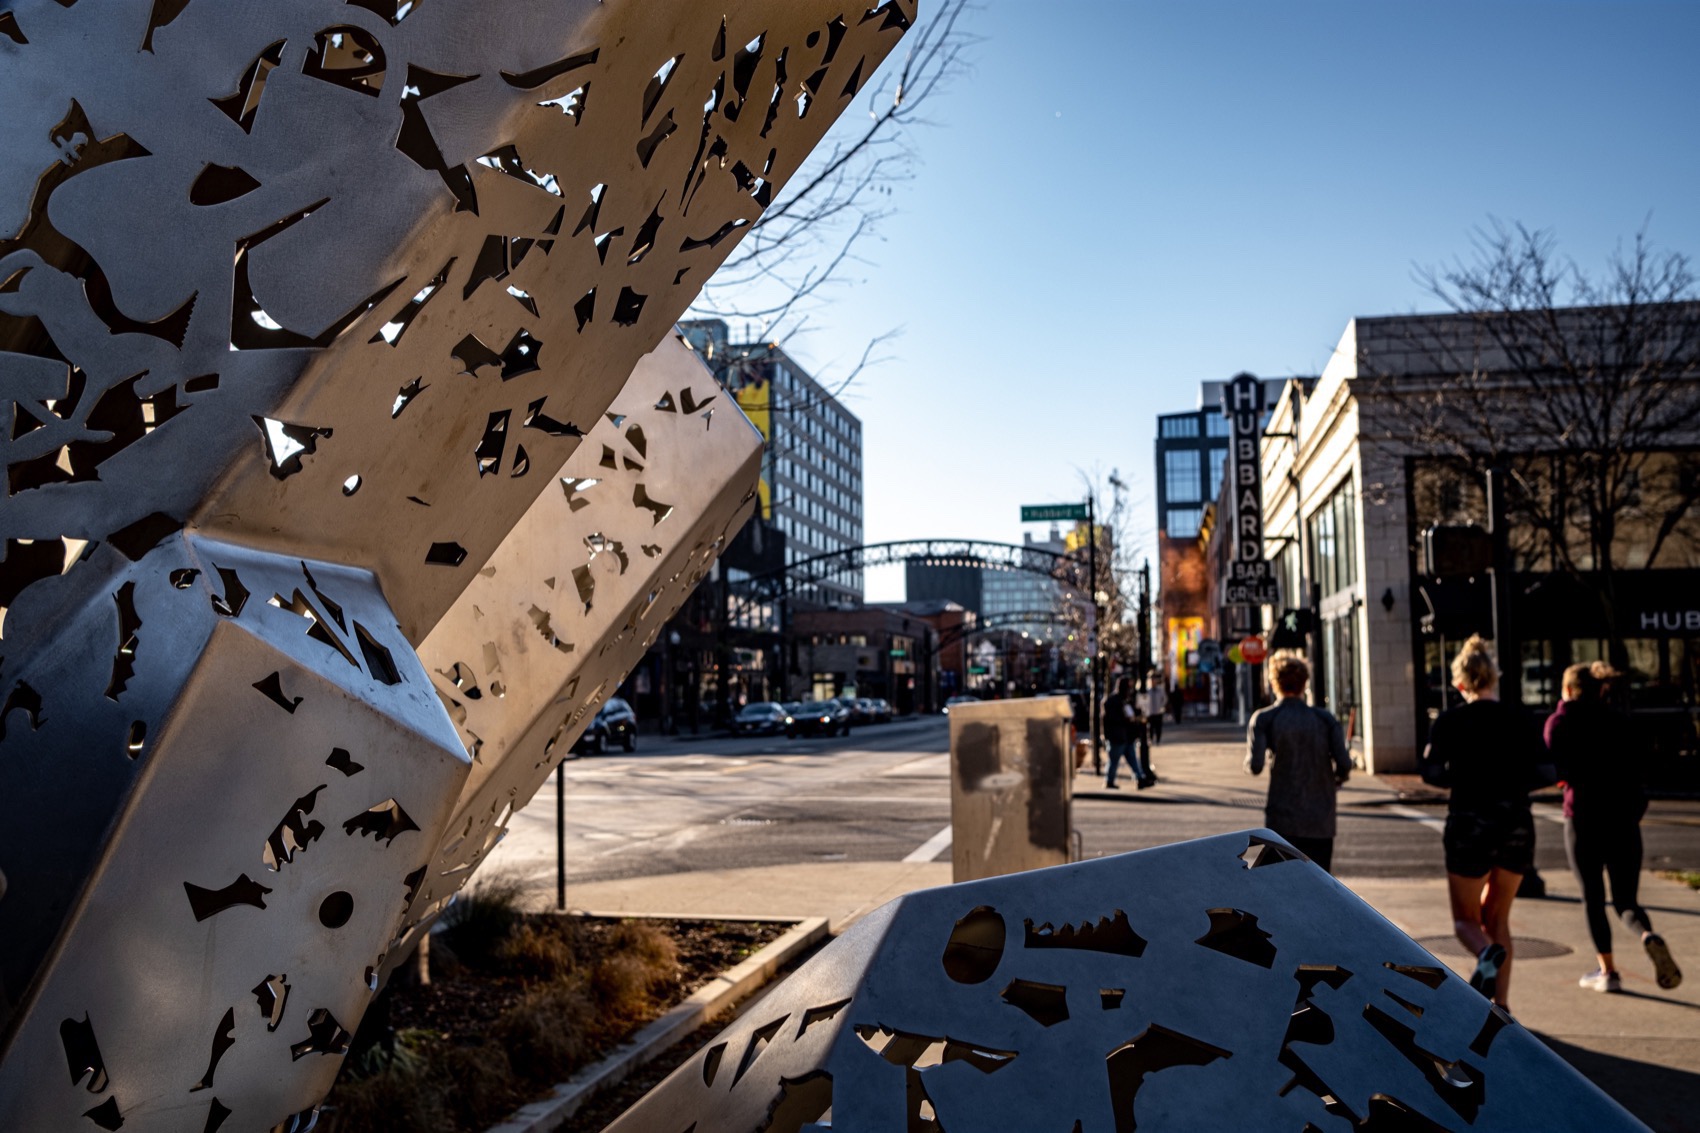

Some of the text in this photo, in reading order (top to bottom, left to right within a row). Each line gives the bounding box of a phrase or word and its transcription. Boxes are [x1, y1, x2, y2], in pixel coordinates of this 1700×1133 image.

[1233, 382, 1260, 562] HUBBARD
[1235, 562, 1266, 579] BAR
[1227, 585, 1276, 601] GRILLE
[1640, 610, 1700, 631] HUB
